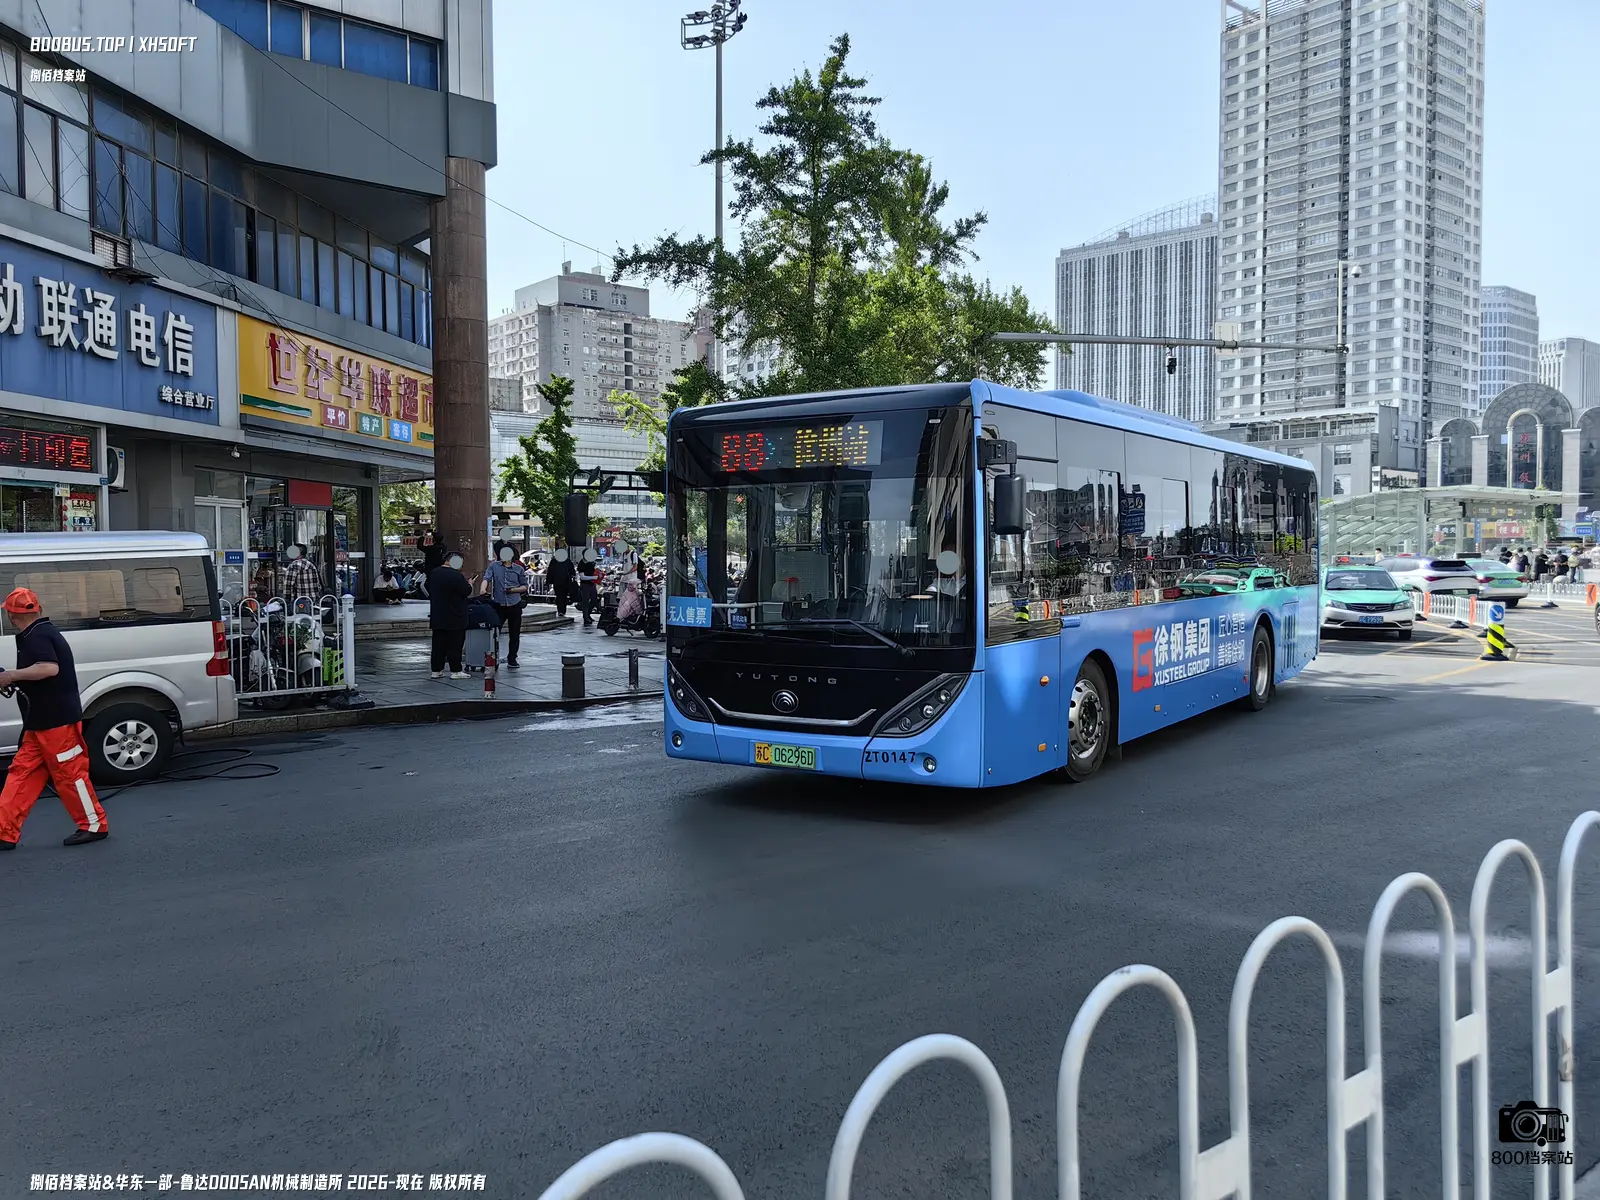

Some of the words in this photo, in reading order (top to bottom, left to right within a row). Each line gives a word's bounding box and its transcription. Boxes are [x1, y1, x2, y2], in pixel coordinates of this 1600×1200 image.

[161, 385, 215, 410] 综合营业厅
[326, 407, 346, 426] 平价
[361, 418, 380, 432] 特产
[721, 433, 763, 471] 88
[669, 606, 706, 624] 无人售票
[1154, 618, 1210, 667] 徐钢集团
[736, 672, 837, 684] YUTONG
[1154, 664, 1187, 686] XUSTEEL
[1187, 658, 1210, 677] GROUP
[865, 751, 916, 763] ZT0147
